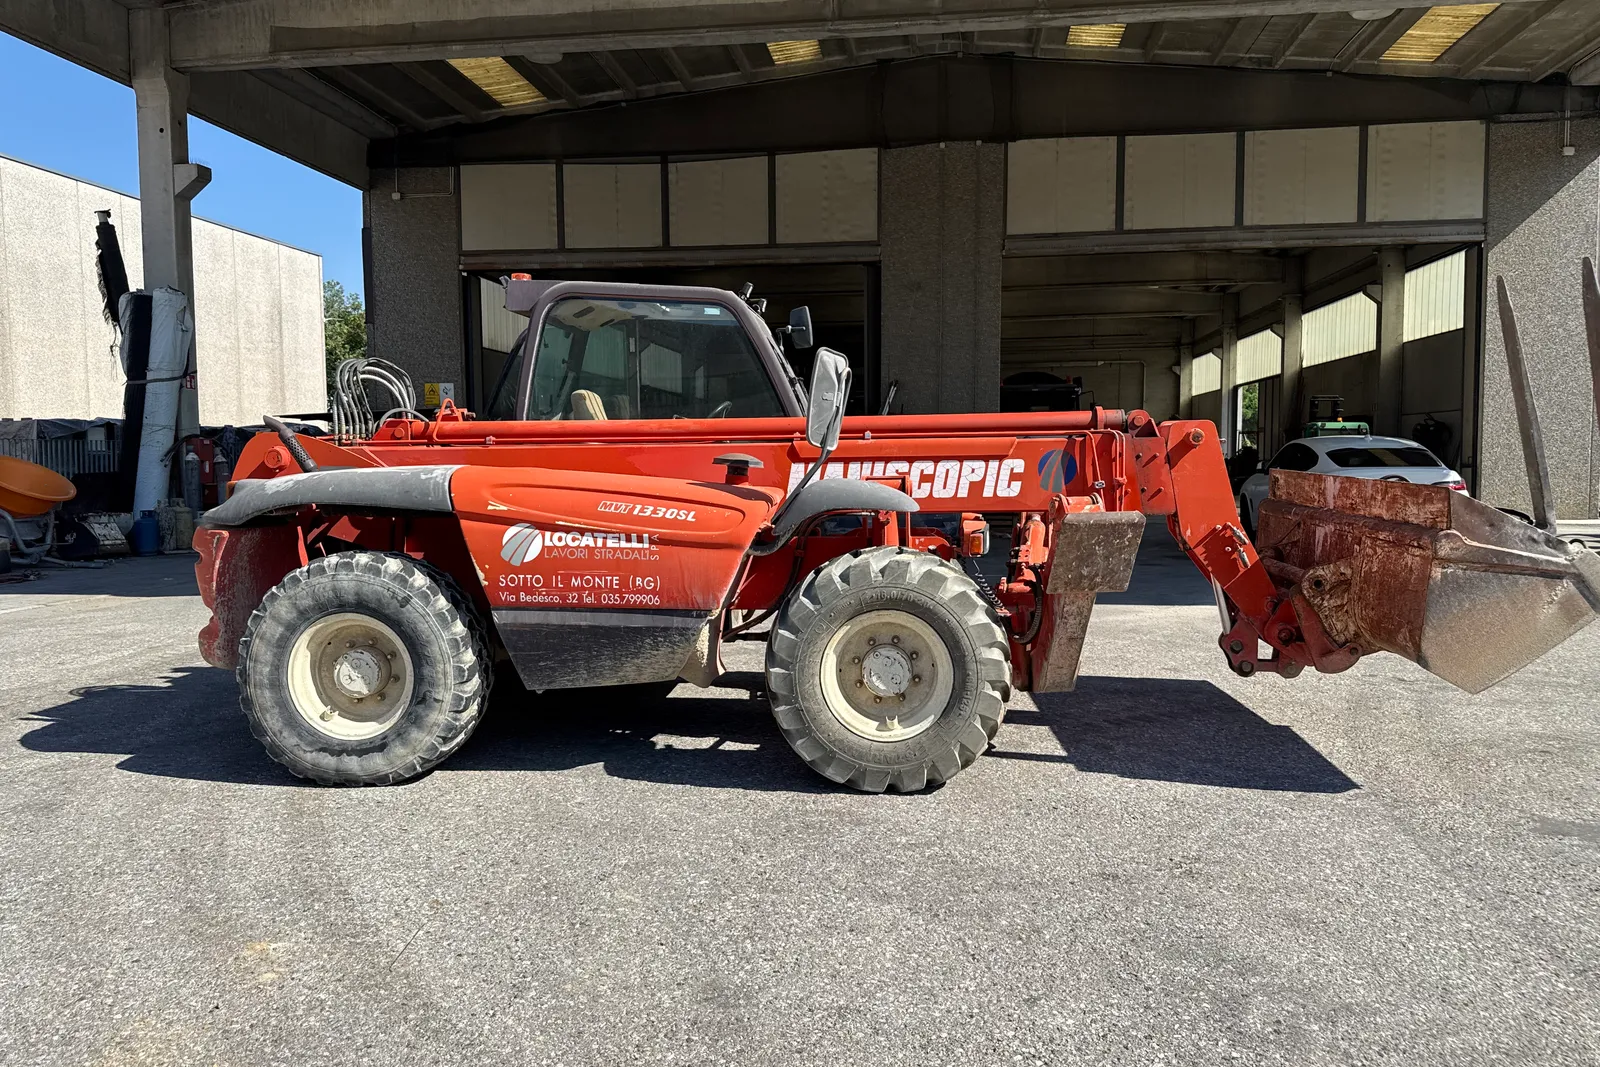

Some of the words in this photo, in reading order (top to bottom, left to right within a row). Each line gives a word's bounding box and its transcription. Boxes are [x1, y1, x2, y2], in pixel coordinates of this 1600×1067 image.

[597, 500, 633, 514] MVT
[632, 504, 697, 522] 1330SL
[544, 531, 650, 549] LOCATELLI
[544, 547, 588, 559] LAVORI
[594, 548, 650, 561] STRADALI
[499, 574, 544, 587] SOTTO
[552, 575, 564, 588] IL
[570, 575, 620, 588] MONTE
[629, 574, 661, 591] (BG)
[499, 592, 516, 602] Via
[519, 592, 562, 604] Bedesco,
[566, 593, 579, 604] 32
[583, 592, 597, 604] Tel.
[601, 594, 661, 606] 035.799906
